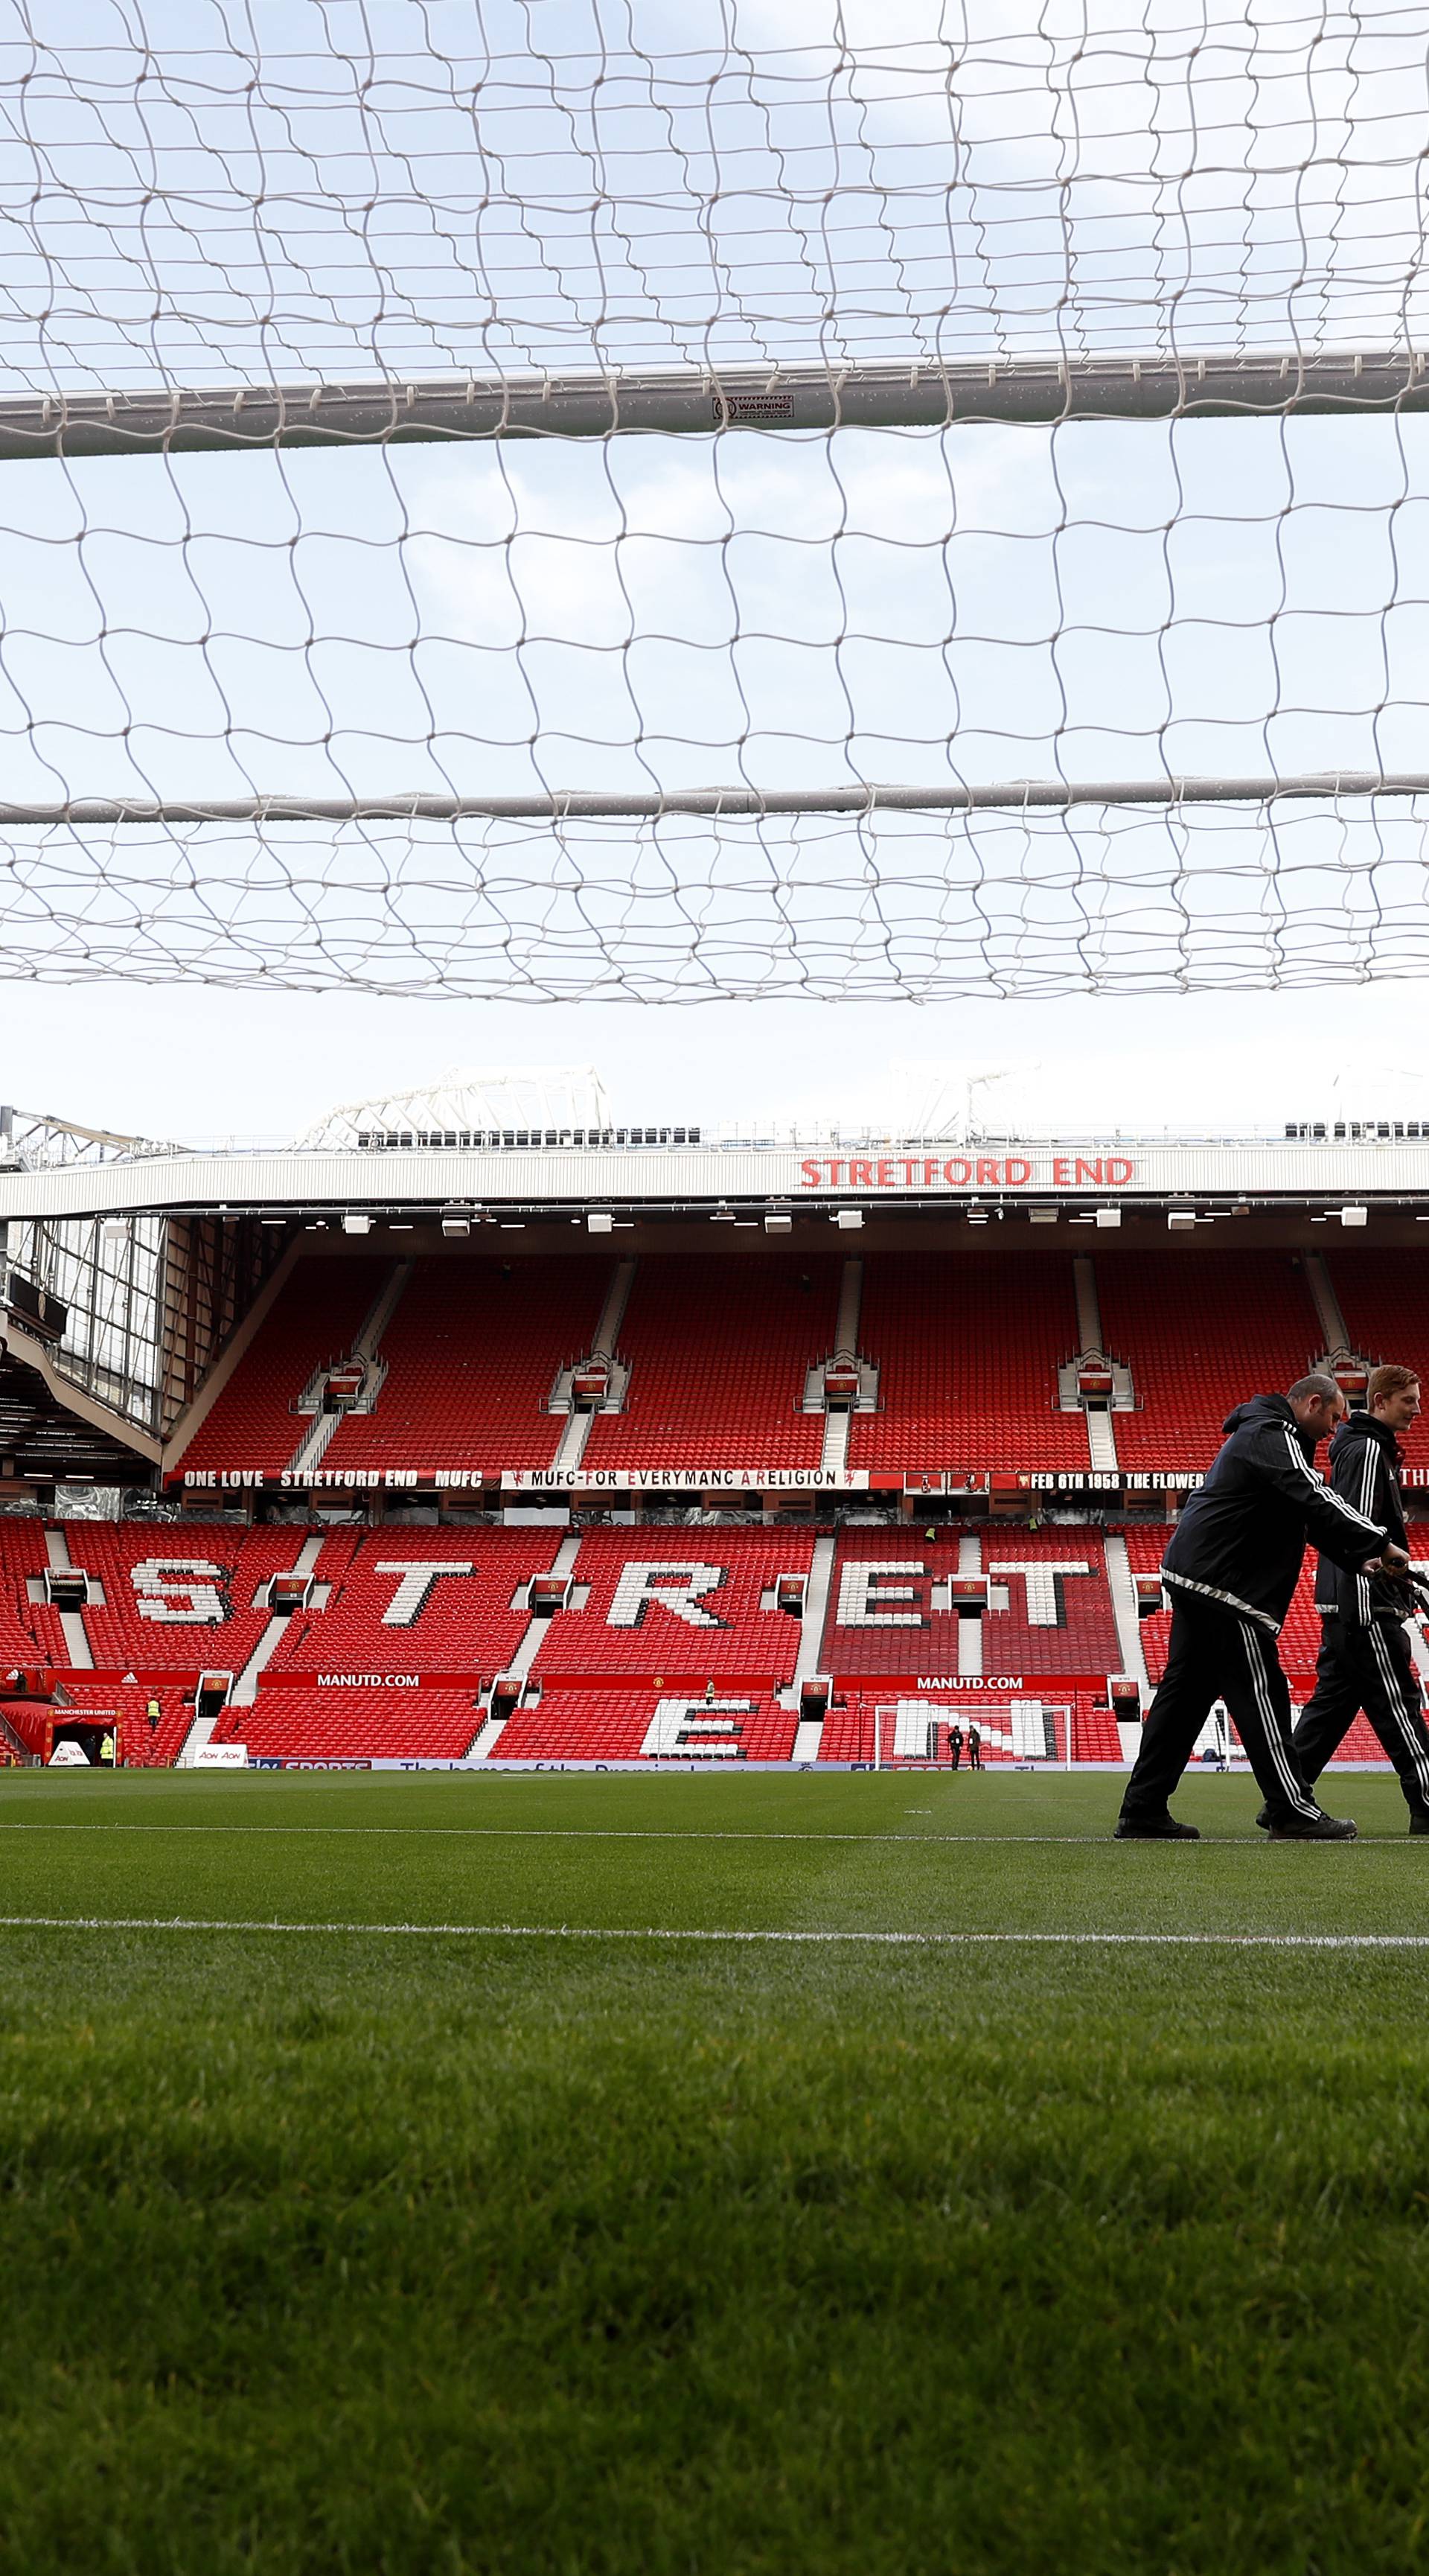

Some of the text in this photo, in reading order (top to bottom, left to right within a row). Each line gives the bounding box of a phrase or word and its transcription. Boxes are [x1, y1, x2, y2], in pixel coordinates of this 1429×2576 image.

[802, 1158, 1134, 1187] STRETFORD END
[185, 1471, 263, 1487] ONE LOVE
[281, 1470, 418, 1488] STRETFORD END
[435, 1470, 482, 1488] MUFC
[628, 1470, 734, 1485] EVERYMANC
[742, 1471, 751, 1485] A
[756, 1470, 837, 1485] RELIGION
[1031, 1473, 1207, 1489] FEB 6TH 1958 THE FLOWER
[1399, 1468, 1429, 1486] TH
[317, 1674, 419, 1688] MANUTD.COM
[917, 1677, 1023, 1690] MANUTD.COM
